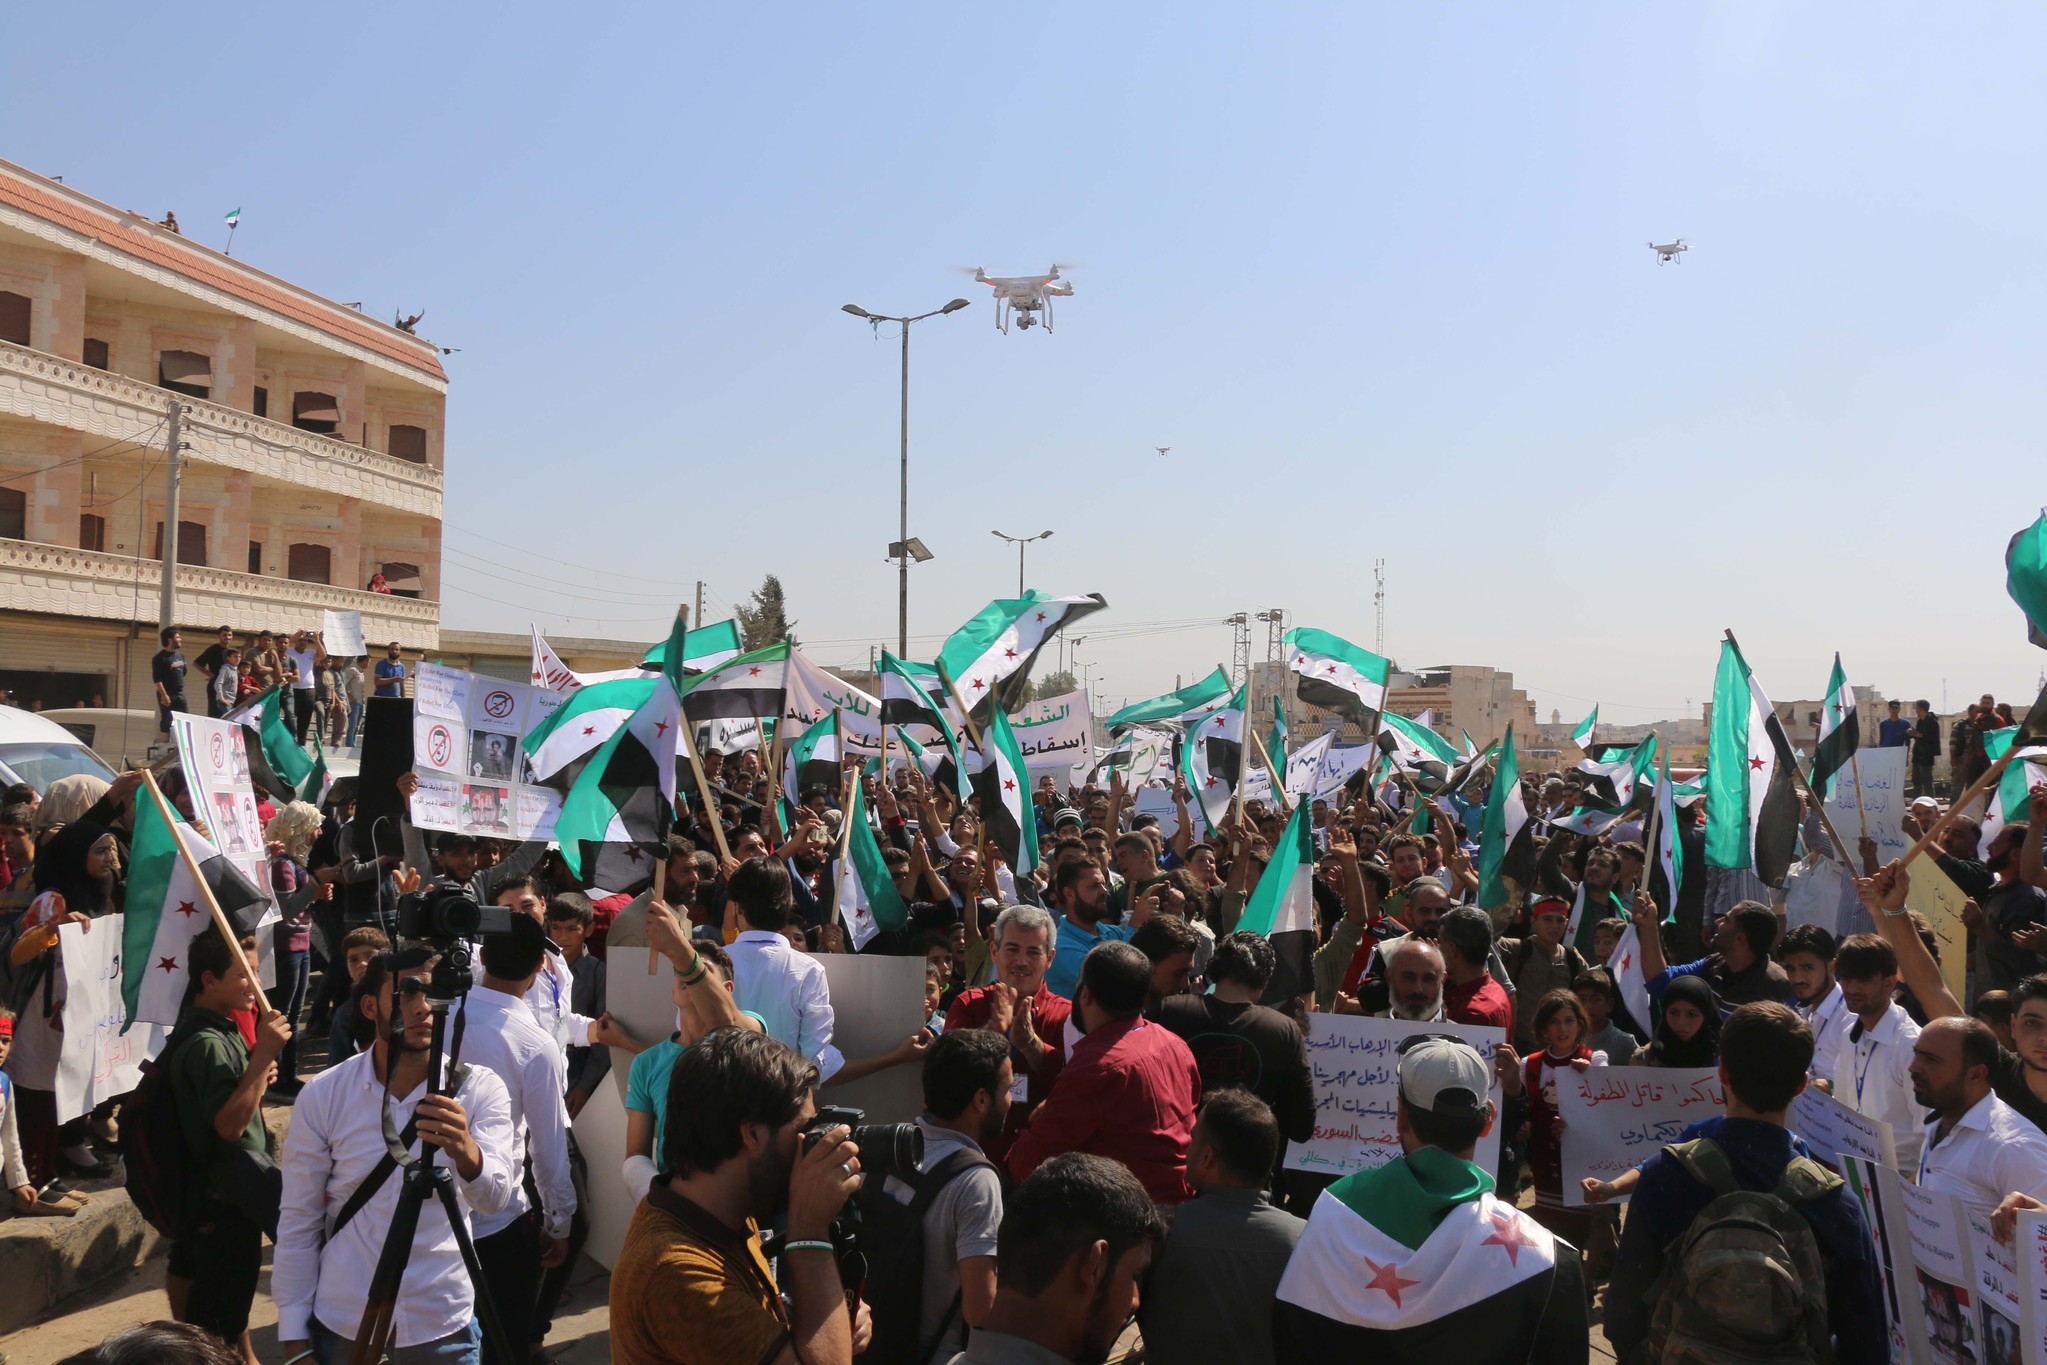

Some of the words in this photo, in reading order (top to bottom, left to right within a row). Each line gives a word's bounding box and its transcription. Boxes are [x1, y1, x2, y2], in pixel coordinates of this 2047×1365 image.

[1021, 731, 1088, 757] إسقاط
[1348, 1036, 1391, 1057] الإرهاب
[1577, 1078, 1630, 1107] الطفولة
[1631, 1081, 1664, 1107] قاتل
